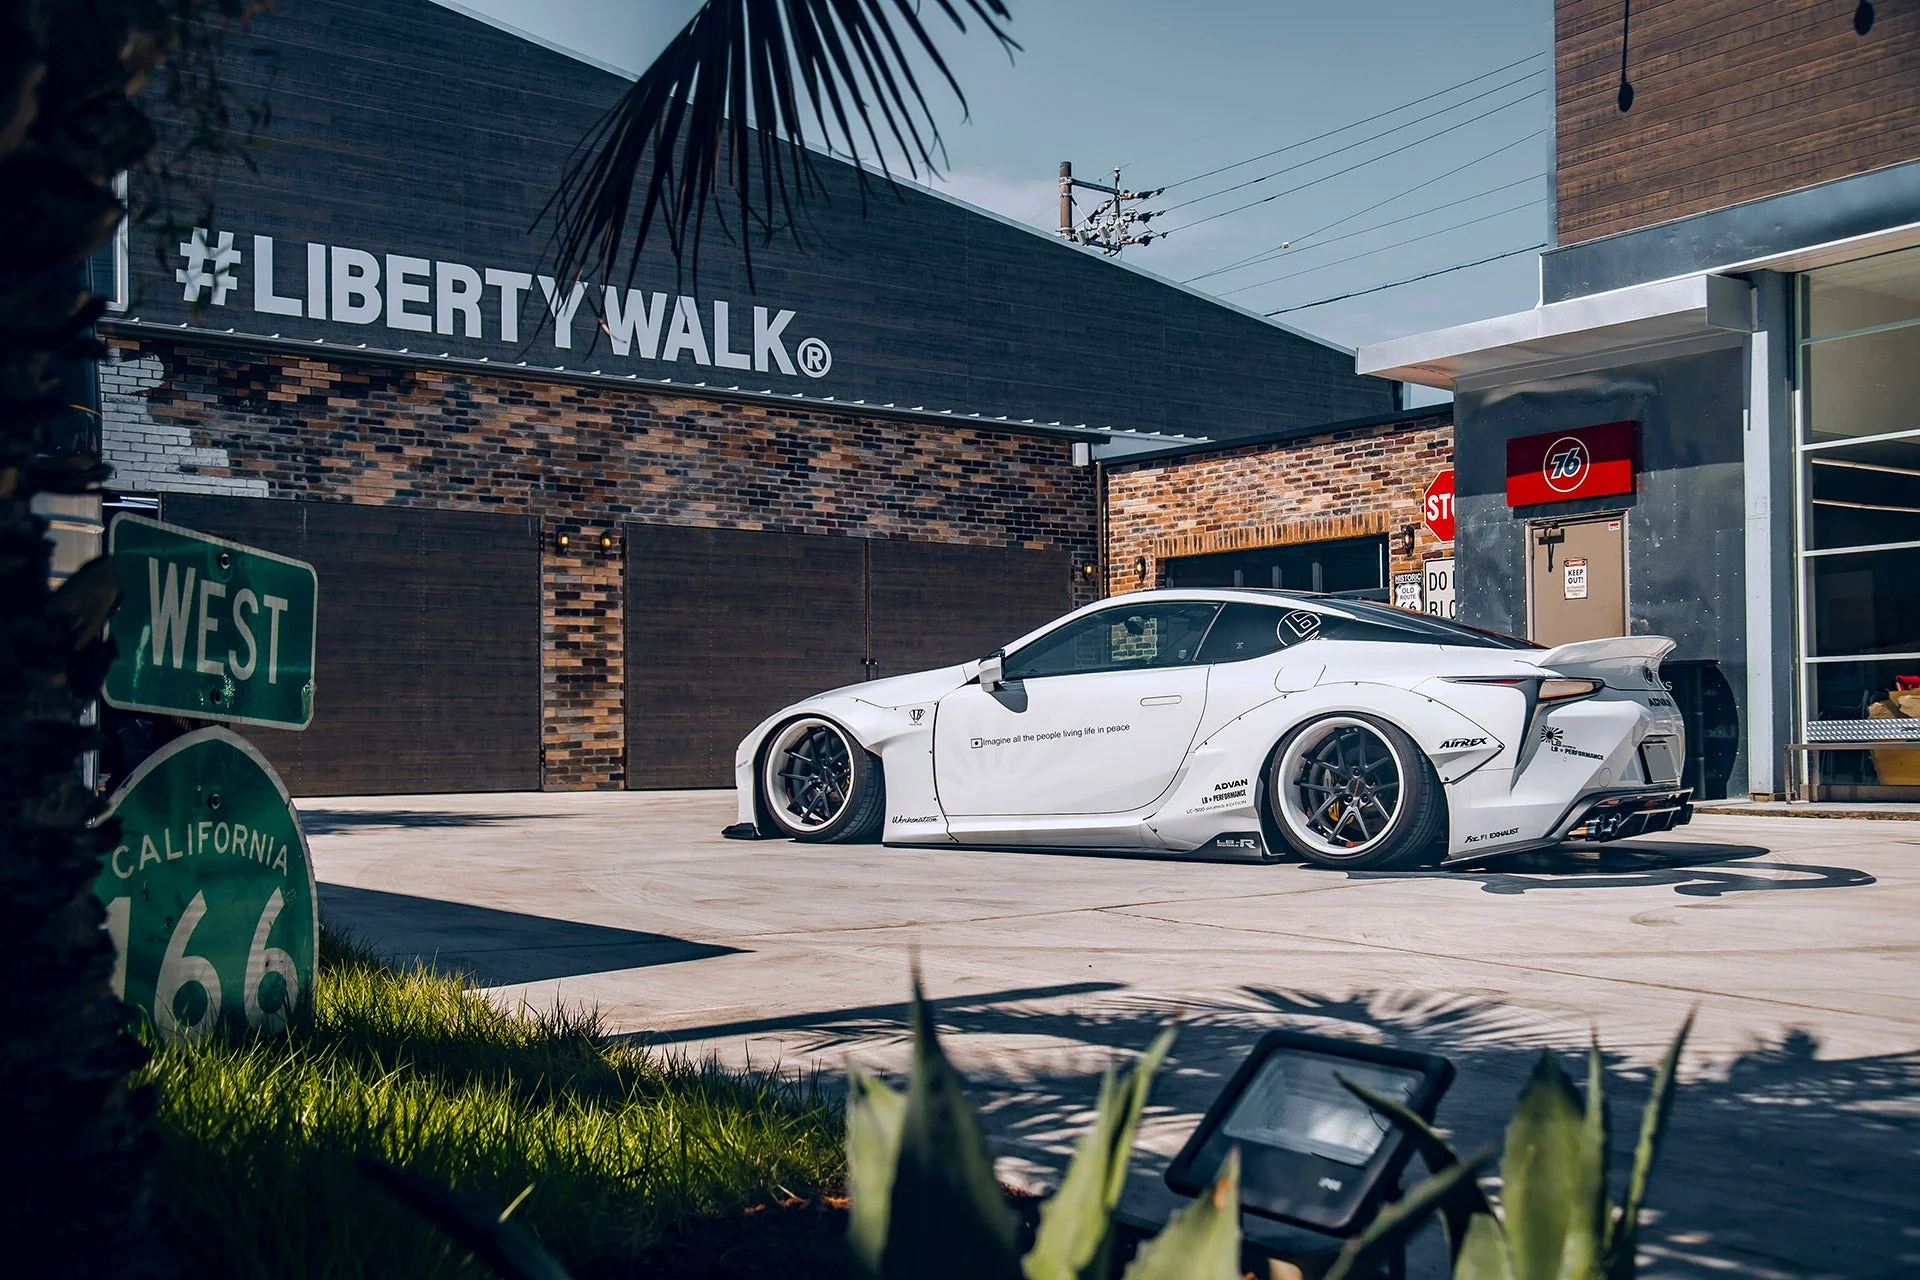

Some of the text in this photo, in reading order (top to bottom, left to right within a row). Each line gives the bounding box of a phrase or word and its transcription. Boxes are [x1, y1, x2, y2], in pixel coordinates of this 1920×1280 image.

[1551, 447, 1582, 479] 76
[1429, 571, 1447, 591] DO
[148, 557, 289, 684] WEST
[1013, 734, 1021, 743] all
[1023, 734, 1035, 742] the
[1036, 731, 1061, 742] people
[1063, 728, 1082, 738] living
[1084, 726, 1096, 735] life
[1097, 726, 1104, 734] in
[1106, 724, 1130, 735] peace
[1565, 748, 1604, 761] PERFORMANCE
[1214, 778, 1248, 791] ADVAN
[1201, 789, 1246, 804] LB PERFORMANCE
[1489, 827, 1519, 839] EXHAUST
[112, 821, 287, 879] CALIFORNIA
